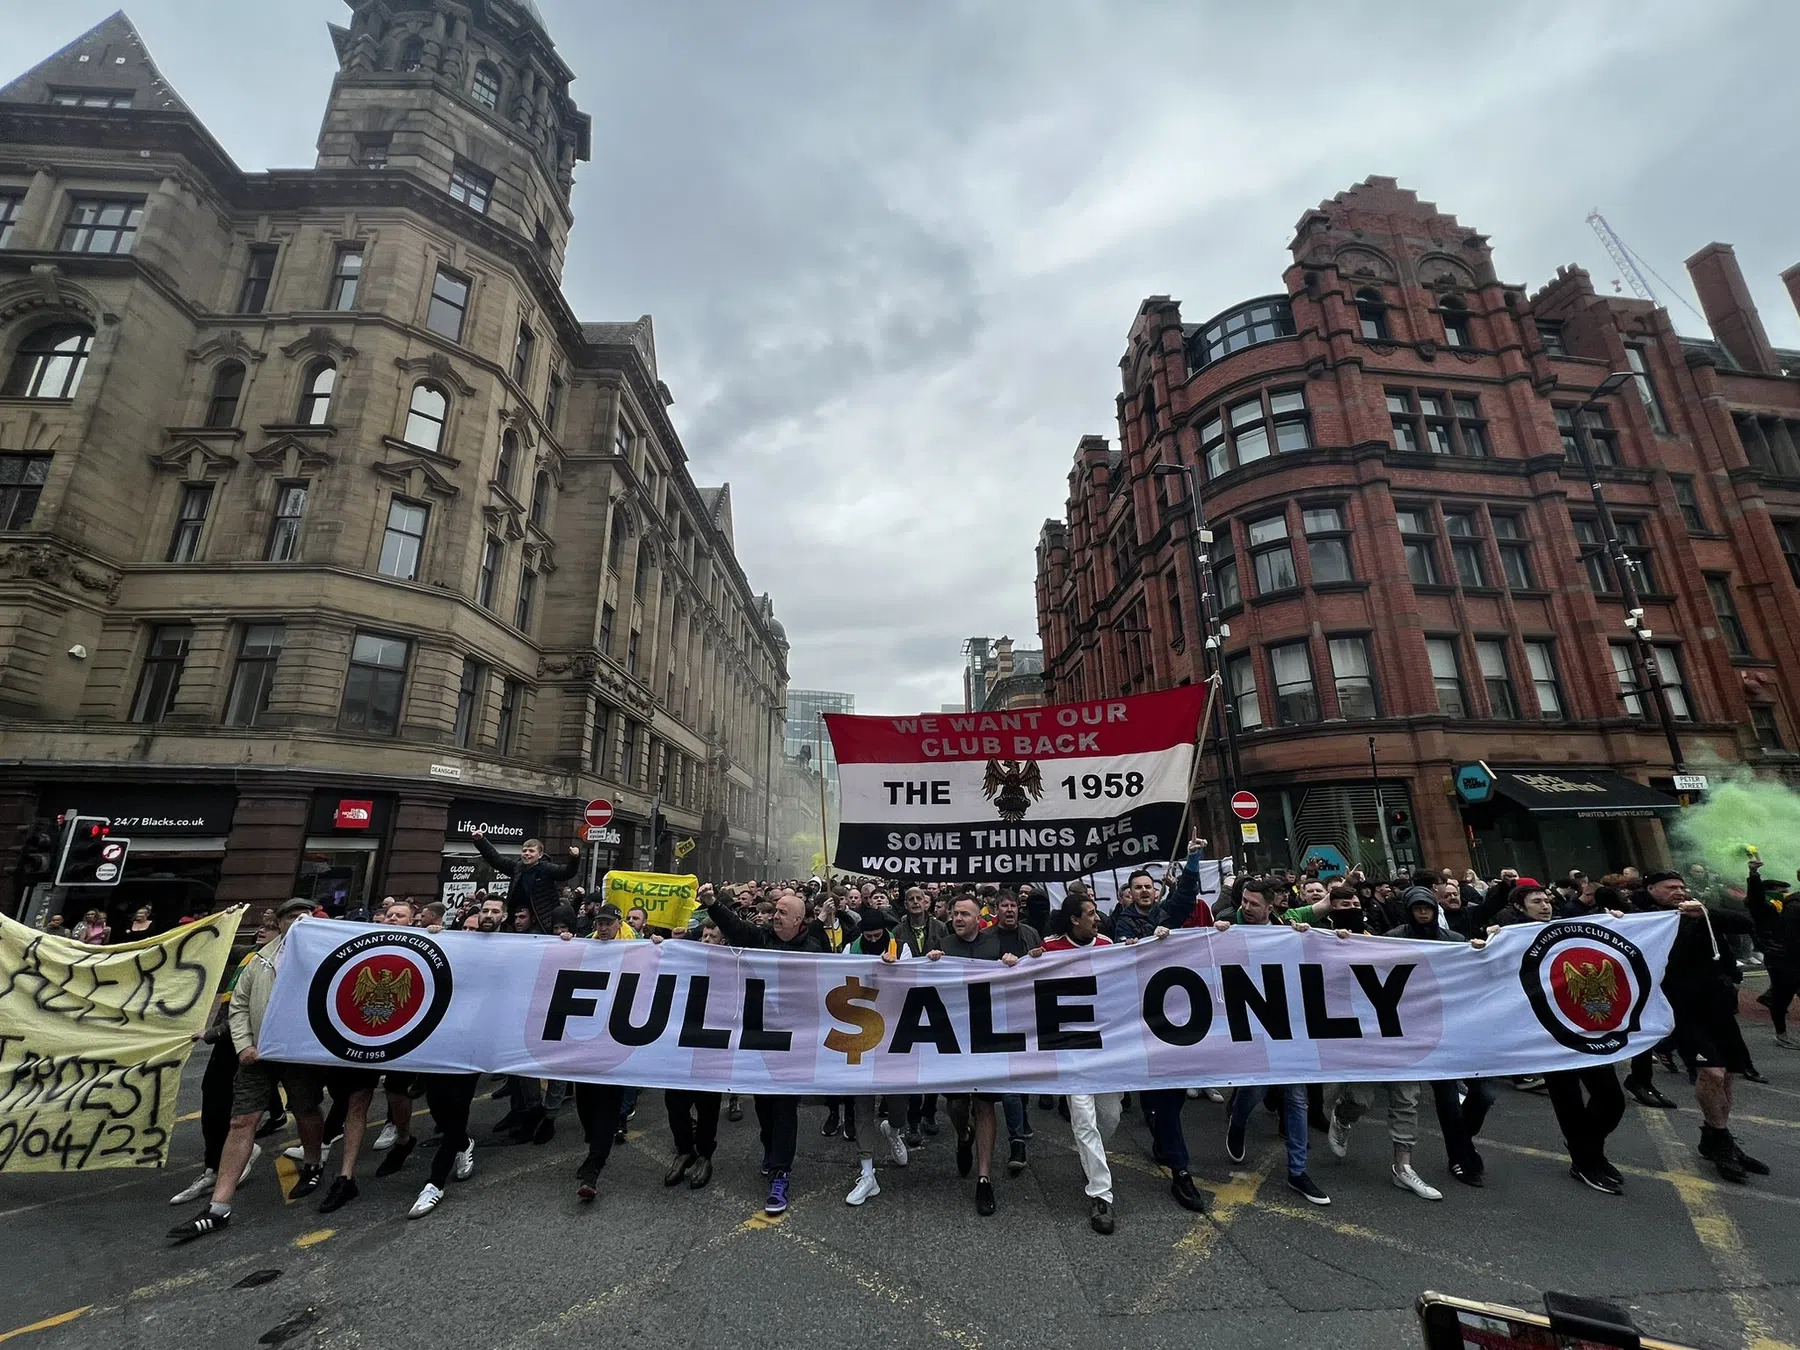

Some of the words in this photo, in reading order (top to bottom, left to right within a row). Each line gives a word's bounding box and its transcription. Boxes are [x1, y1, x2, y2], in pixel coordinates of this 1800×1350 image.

[892, 719, 939, 734] WE
[950, 712, 1043, 732] WANT
[1056, 703, 1129, 727] OUR
[921, 736, 1001, 757] CLUB
[1013, 731, 1100, 755] BACK
[883, 781, 951, 805] THE
[1061, 771, 1144, 800] 1958
[113, 817, 140, 826] 24/7
[141, 817, 205, 827] Blacks.co.uk
[457, 820, 476, 833] Life
[480, 822, 524, 836] Outdoors
[887, 832, 961, 851] SOME
[971, 828, 1075, 848] THINGS
[1085, 817, 1133, 846] ARE
[861, 856, 958, 875] WORTH
[968, 853, 1098, 874] FIGHTING
[1107, 834, 1160, 860] FOR
[611, 879, 692, 899] GLAZERS
[633, 897, 668, 912] OUT
[336, 947, 353, 959] WE
[353, 934, 386, 949] WANT
[387, 933, 408, 943] OUR
[408, 937, 429, 951] CLUB
[427, 948, 444, 969] BACK
[1530, 945, 1542, 958] WE
[1541, 928, 1563, 945] WANT
[1564, 925, 1583, 934] OUR
[1585, 927, 1610, 940] CLUB
[1612, 936, 1637, 957] BACK
[541, 969, 792, 1052] FULL
[824, 976, 1103, 1065] $ALE
[1143, 963, 1418, 1047] ONLY
[345, 1047, 364, 1059] THE
[365, 1050, 386, 1059] 1958
